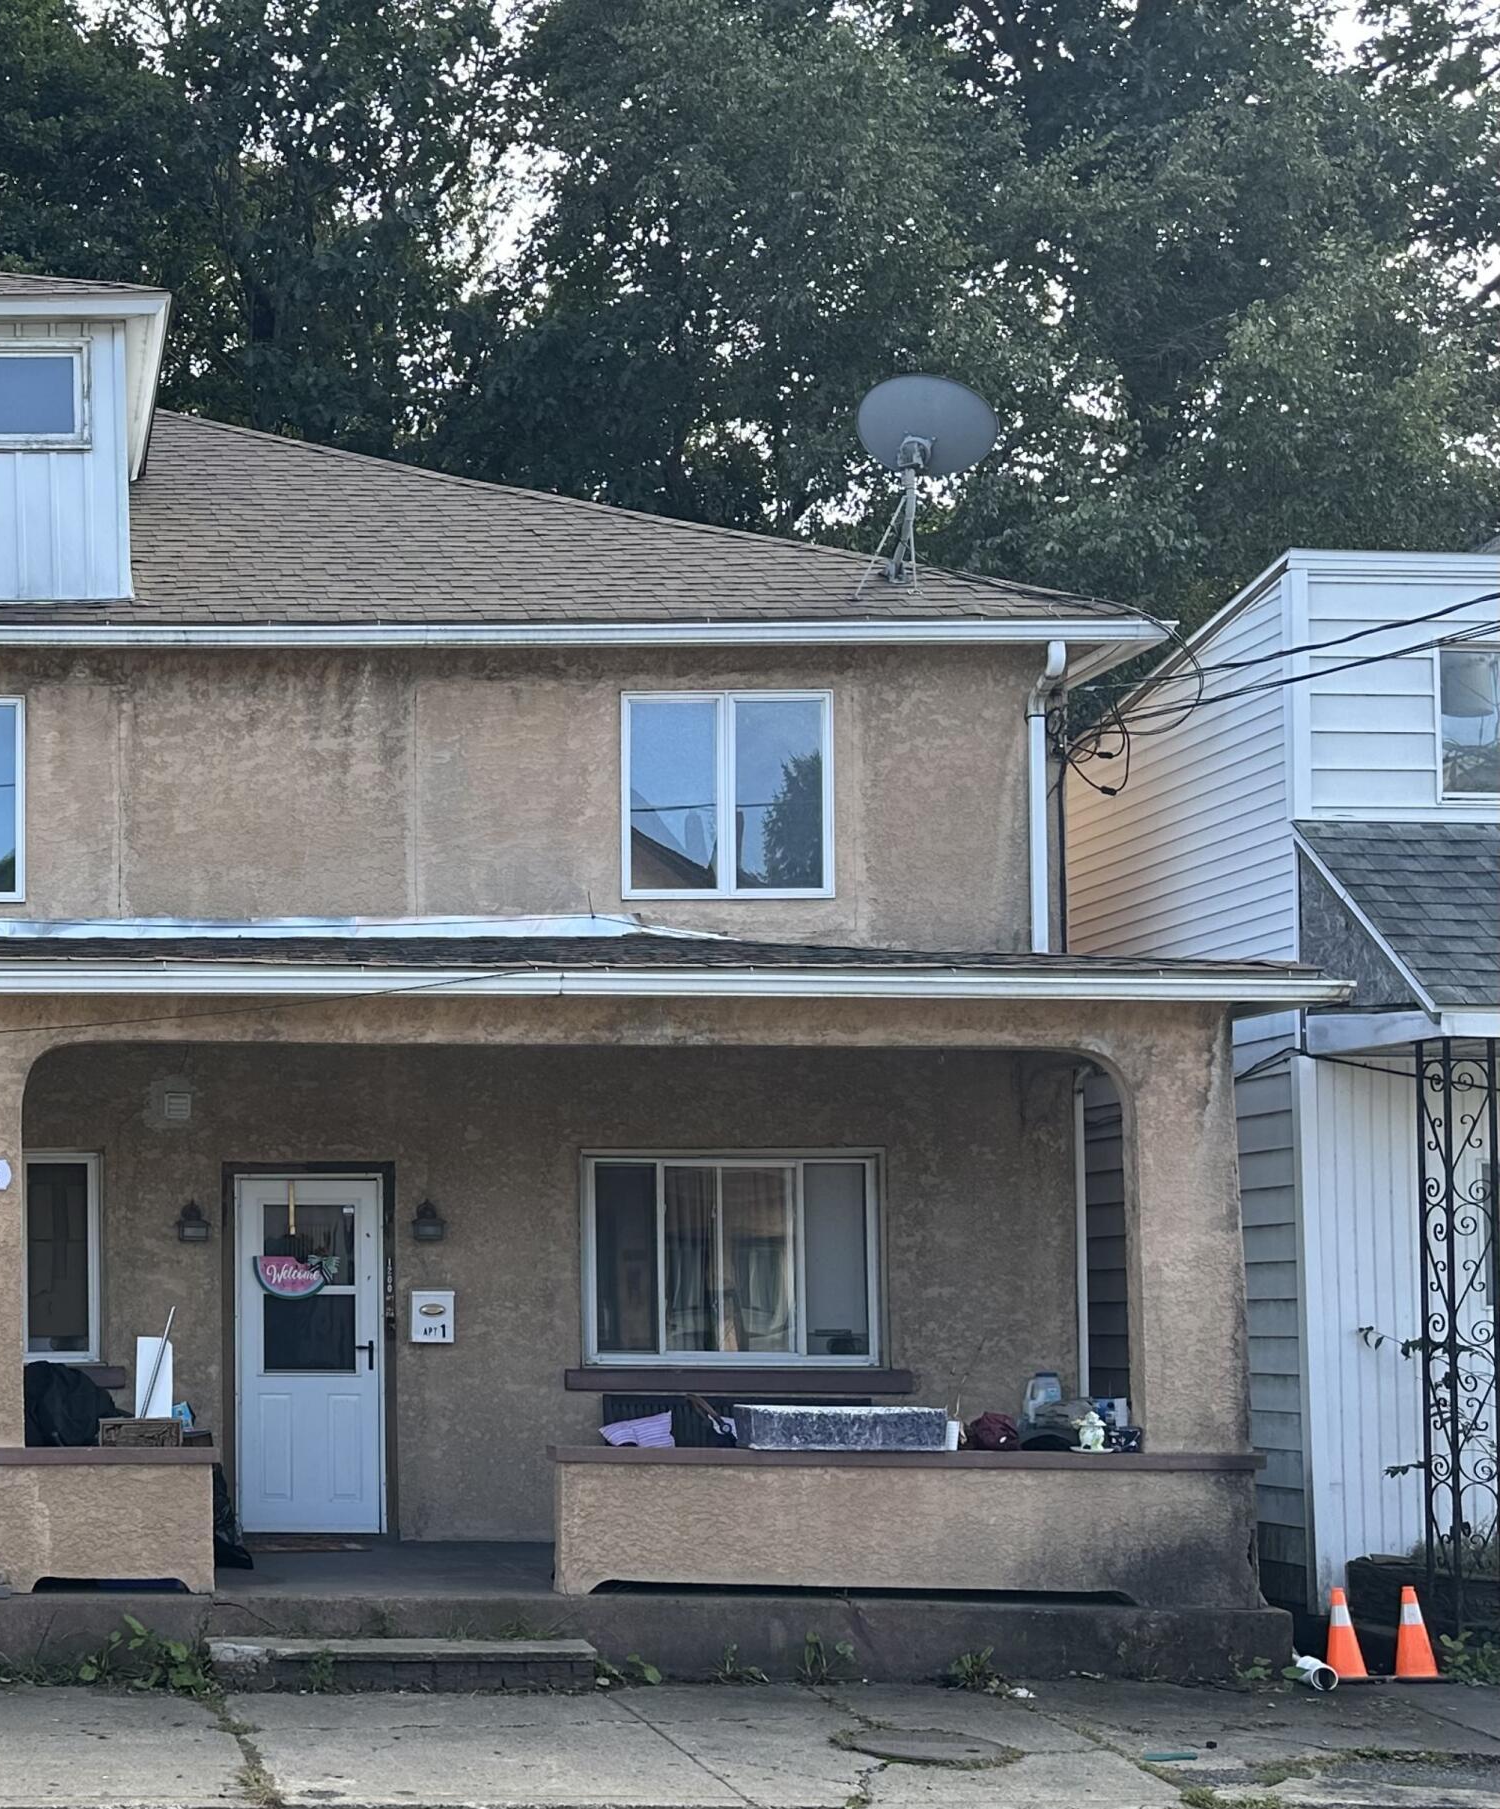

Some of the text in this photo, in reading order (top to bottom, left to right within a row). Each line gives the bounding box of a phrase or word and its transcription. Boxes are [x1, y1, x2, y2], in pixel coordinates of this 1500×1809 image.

[266, 1263, 321, 1285] Welcome
[386, 1257, 395, 1293] 1200
[423, 1323, 447, 1339] APT 1
